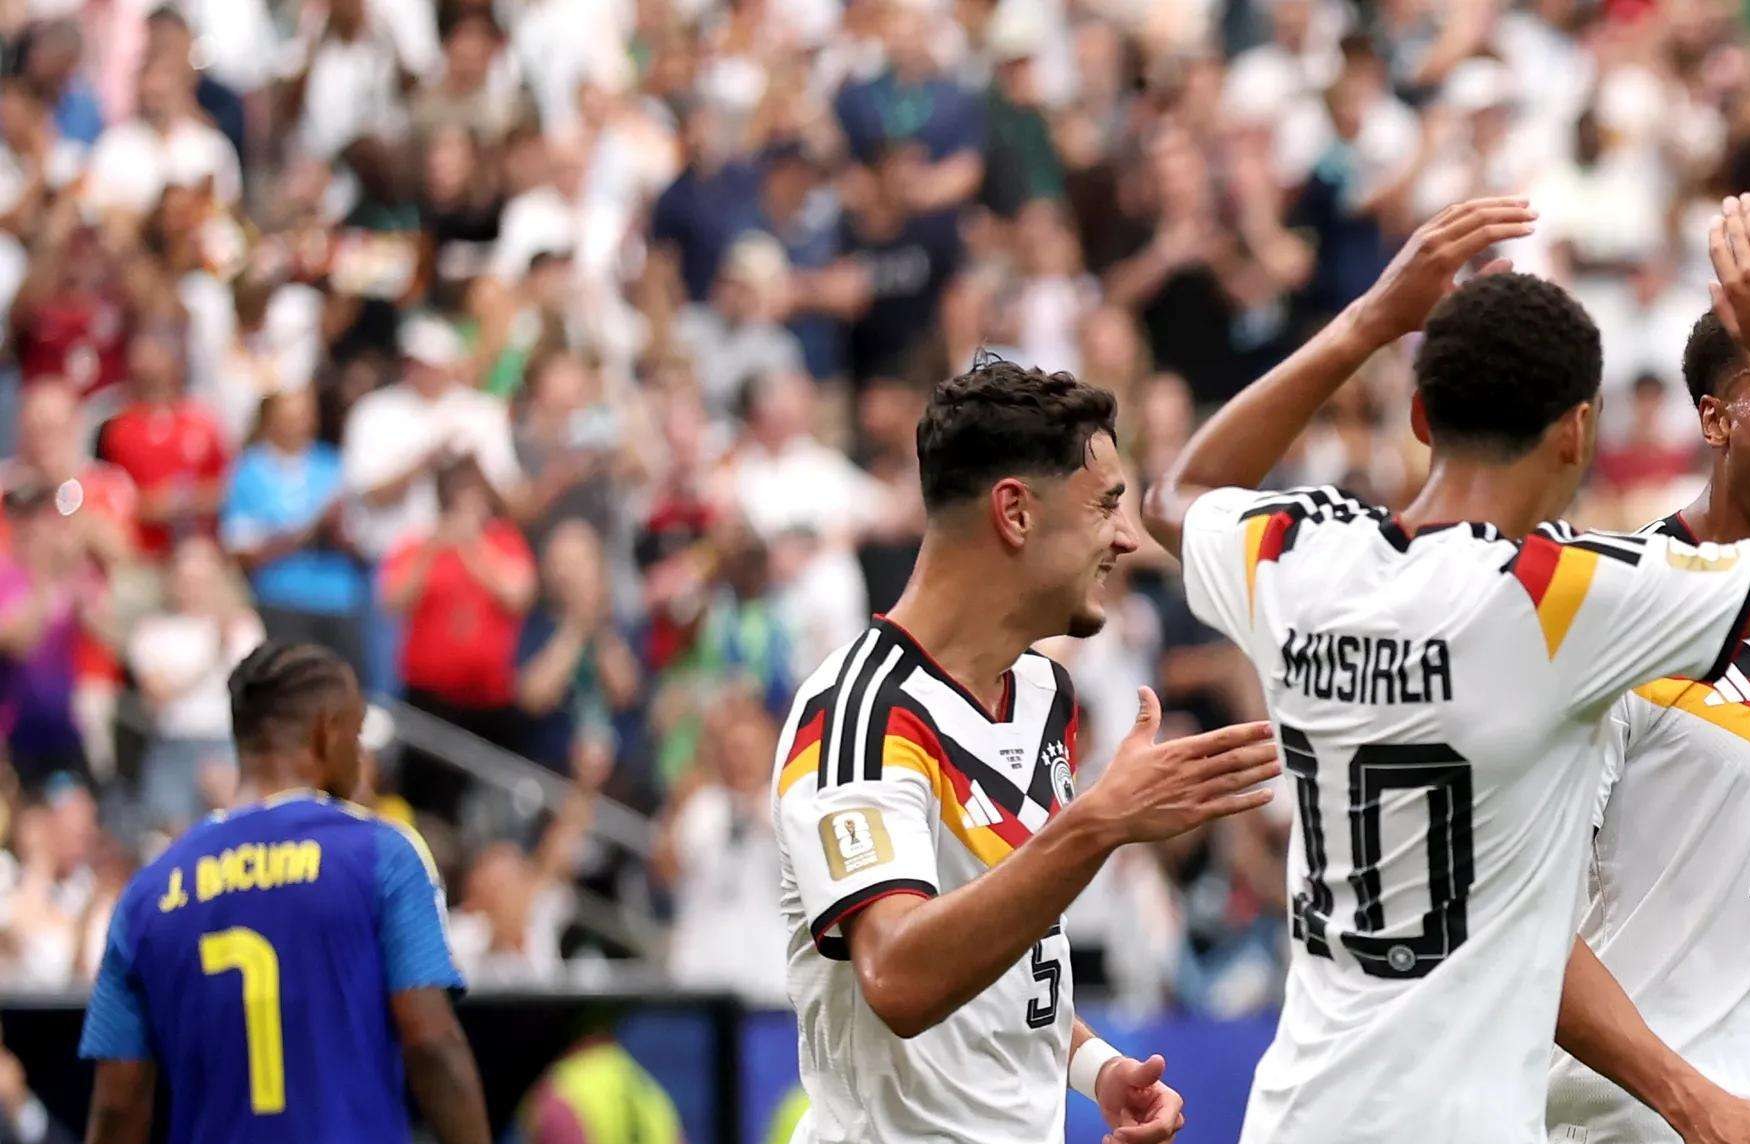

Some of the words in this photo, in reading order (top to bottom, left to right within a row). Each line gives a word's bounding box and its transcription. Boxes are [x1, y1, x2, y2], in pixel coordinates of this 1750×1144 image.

[1281, 628, 1452, 704] MUSIALA
[195, 837, 322, 903] BACUNA
[1280, 723, 1476, 978] 10
[1026, 919, 1062, 1029] 5
